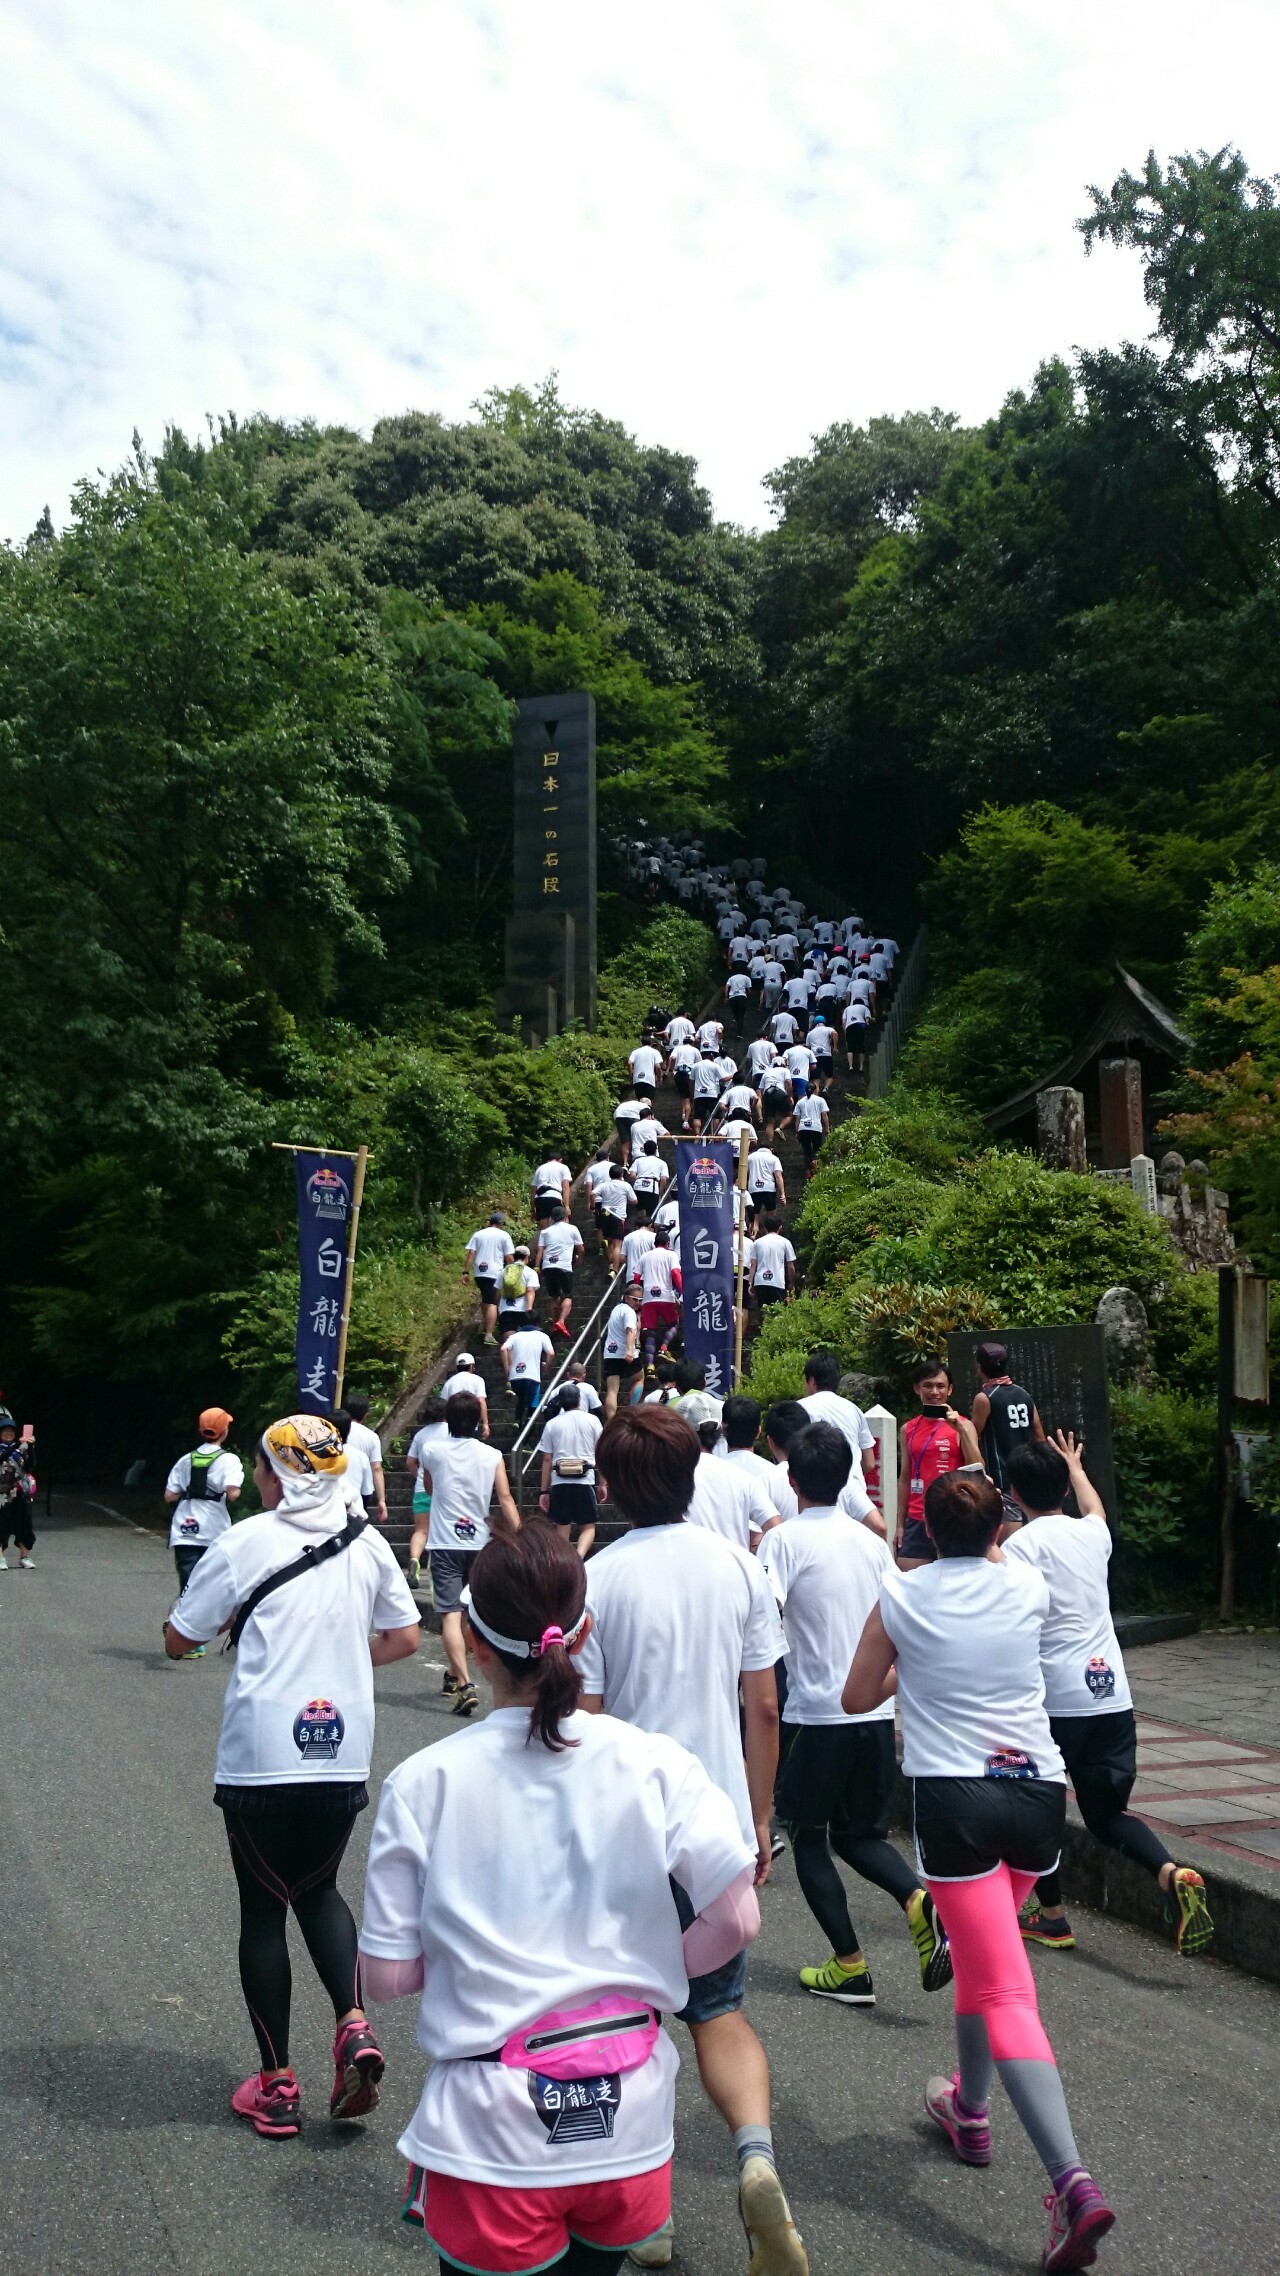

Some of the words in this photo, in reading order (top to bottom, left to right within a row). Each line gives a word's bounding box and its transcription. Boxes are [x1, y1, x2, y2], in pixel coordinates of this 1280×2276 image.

[543, 751, 560, 893] 日本一の石段
[690, 1181, 725, 1194] 白龍走
[300, 1237, 342, 1402] 白龍走
[692, 1227, 728, 1400] 白龍走
[1007, 1403, 1029, 1428] 93
[303, 1710, 319, 1719] Red
[320, 1710, 336, 1719] Bull
[300, 1726, 341, 1741] 白龍走
[991, 1756, 1009, 1767] Red
[1011, 1755, 1028, 1764] Bull
[543, 2077, 618, 2109] 白龍走
